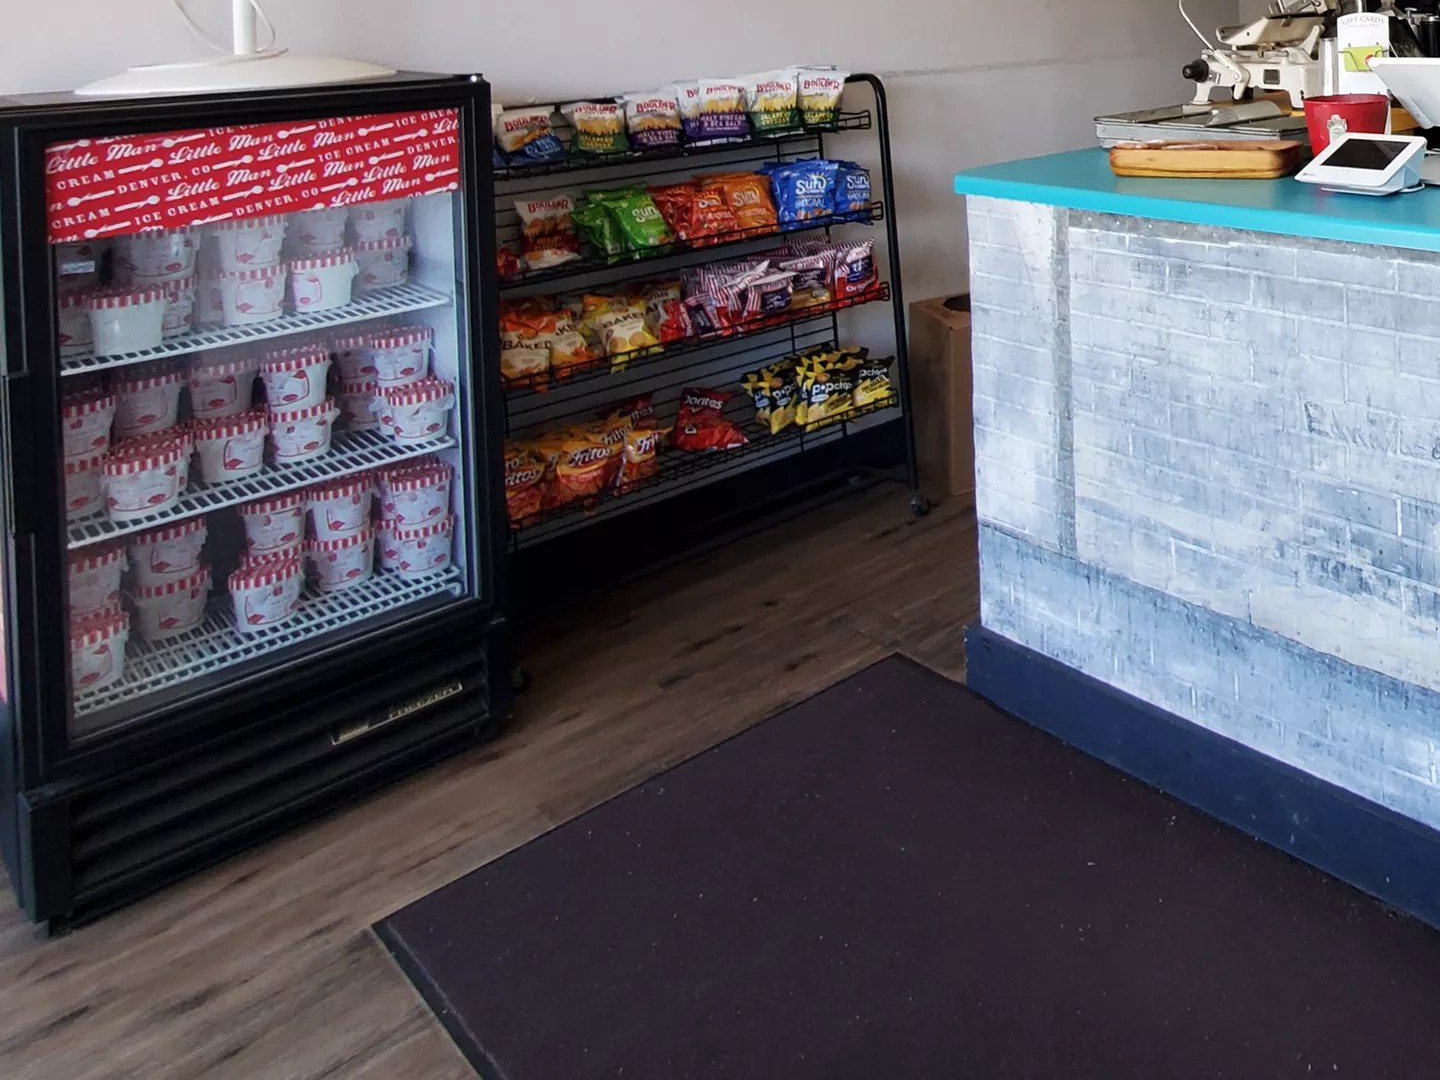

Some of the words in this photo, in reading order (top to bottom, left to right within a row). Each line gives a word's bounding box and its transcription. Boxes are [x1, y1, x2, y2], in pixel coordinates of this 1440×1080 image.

[1342, 16, 1358, 26] GIFT
[1360, 14, 1384, 25] CARDS
[168, 143, 222, 164] Little
[229, 134, 273, 152] Man
[258, 140, 306, 161] Little
[313, 132, 355, 148] Man
[318, 150, 340, 162] ICE
[346, 138, 390, 156] CREAM
[56, 170, 116, 190] CREAM
[192, 165, 211, 176] CO
[362, 162, 406, 184] Little
[412, 154, 450, 170] Man
[331, 186, 376, 208] Little
[382, 178, 420, 194] Man
[796, 179, 826, 194] Sun
[135, 212, 162, 225] ICE
[168, 196, 220, 216] CREAM
